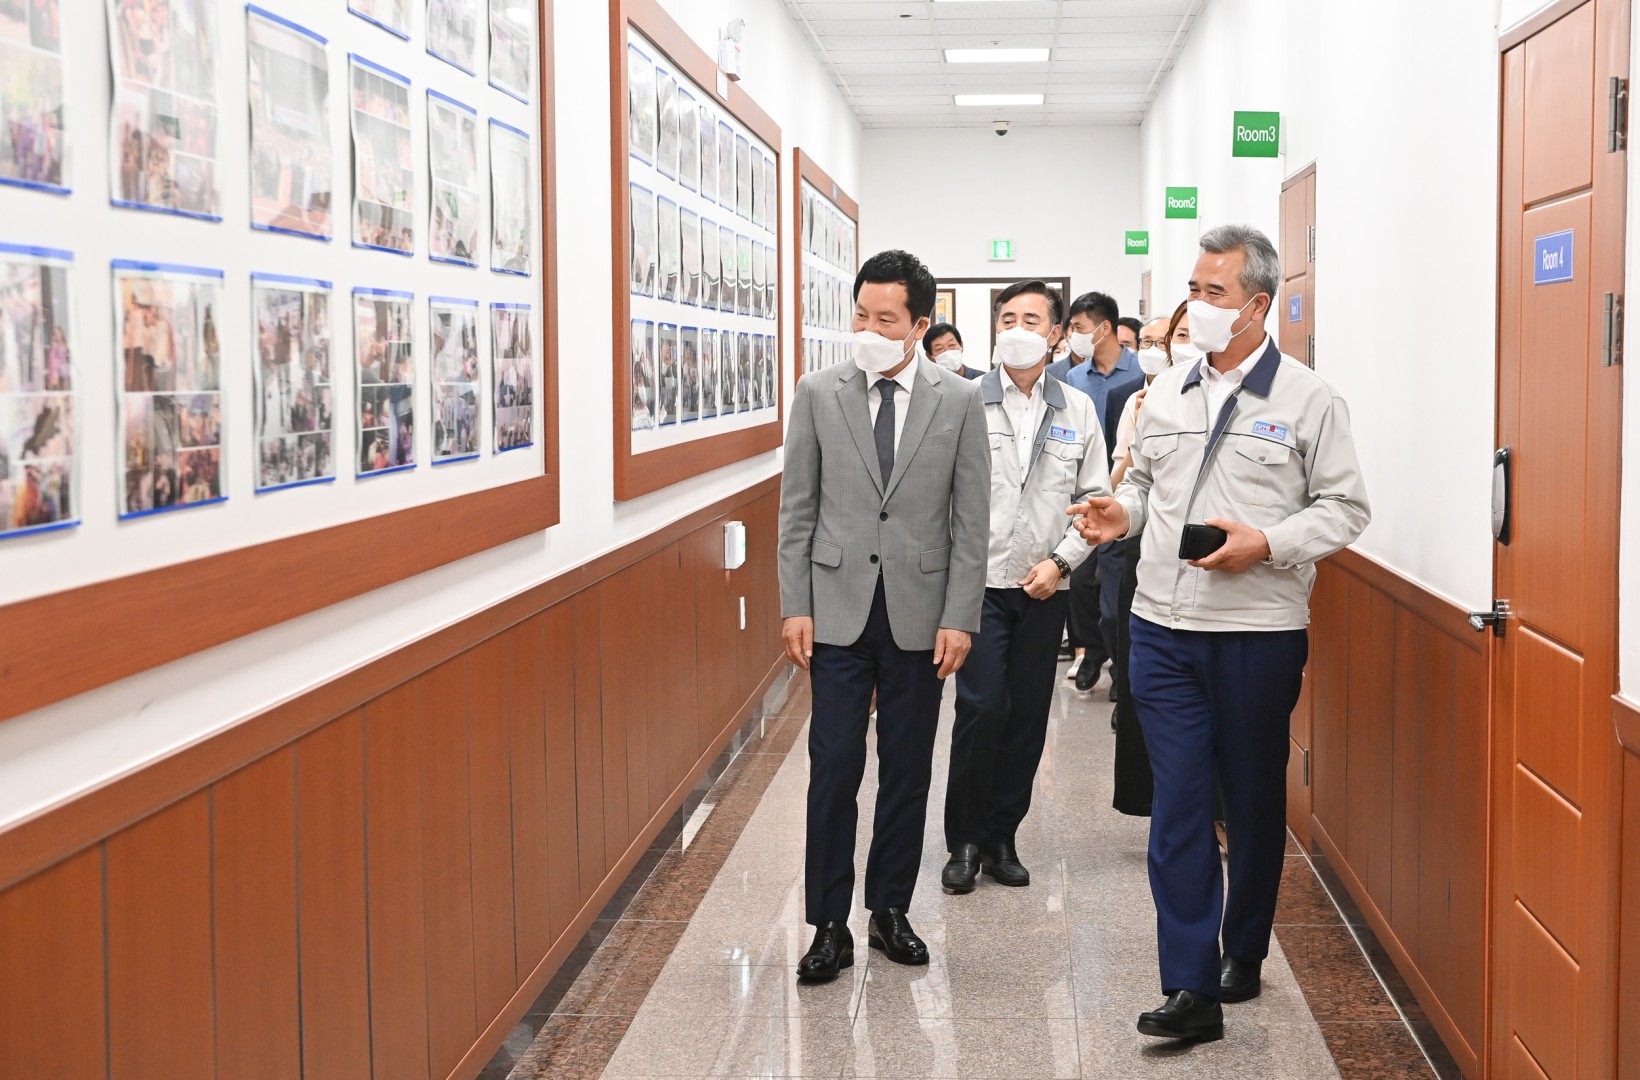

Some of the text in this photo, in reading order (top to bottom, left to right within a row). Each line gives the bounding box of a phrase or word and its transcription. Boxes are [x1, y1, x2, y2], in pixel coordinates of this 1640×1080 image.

[1237, 125, 1276, 142] Room3
[1168, 196, 1196, 209] Room2
[1127, 238, 1147, 247] Room1
[1542, 245, 1564, 270] Room 4
